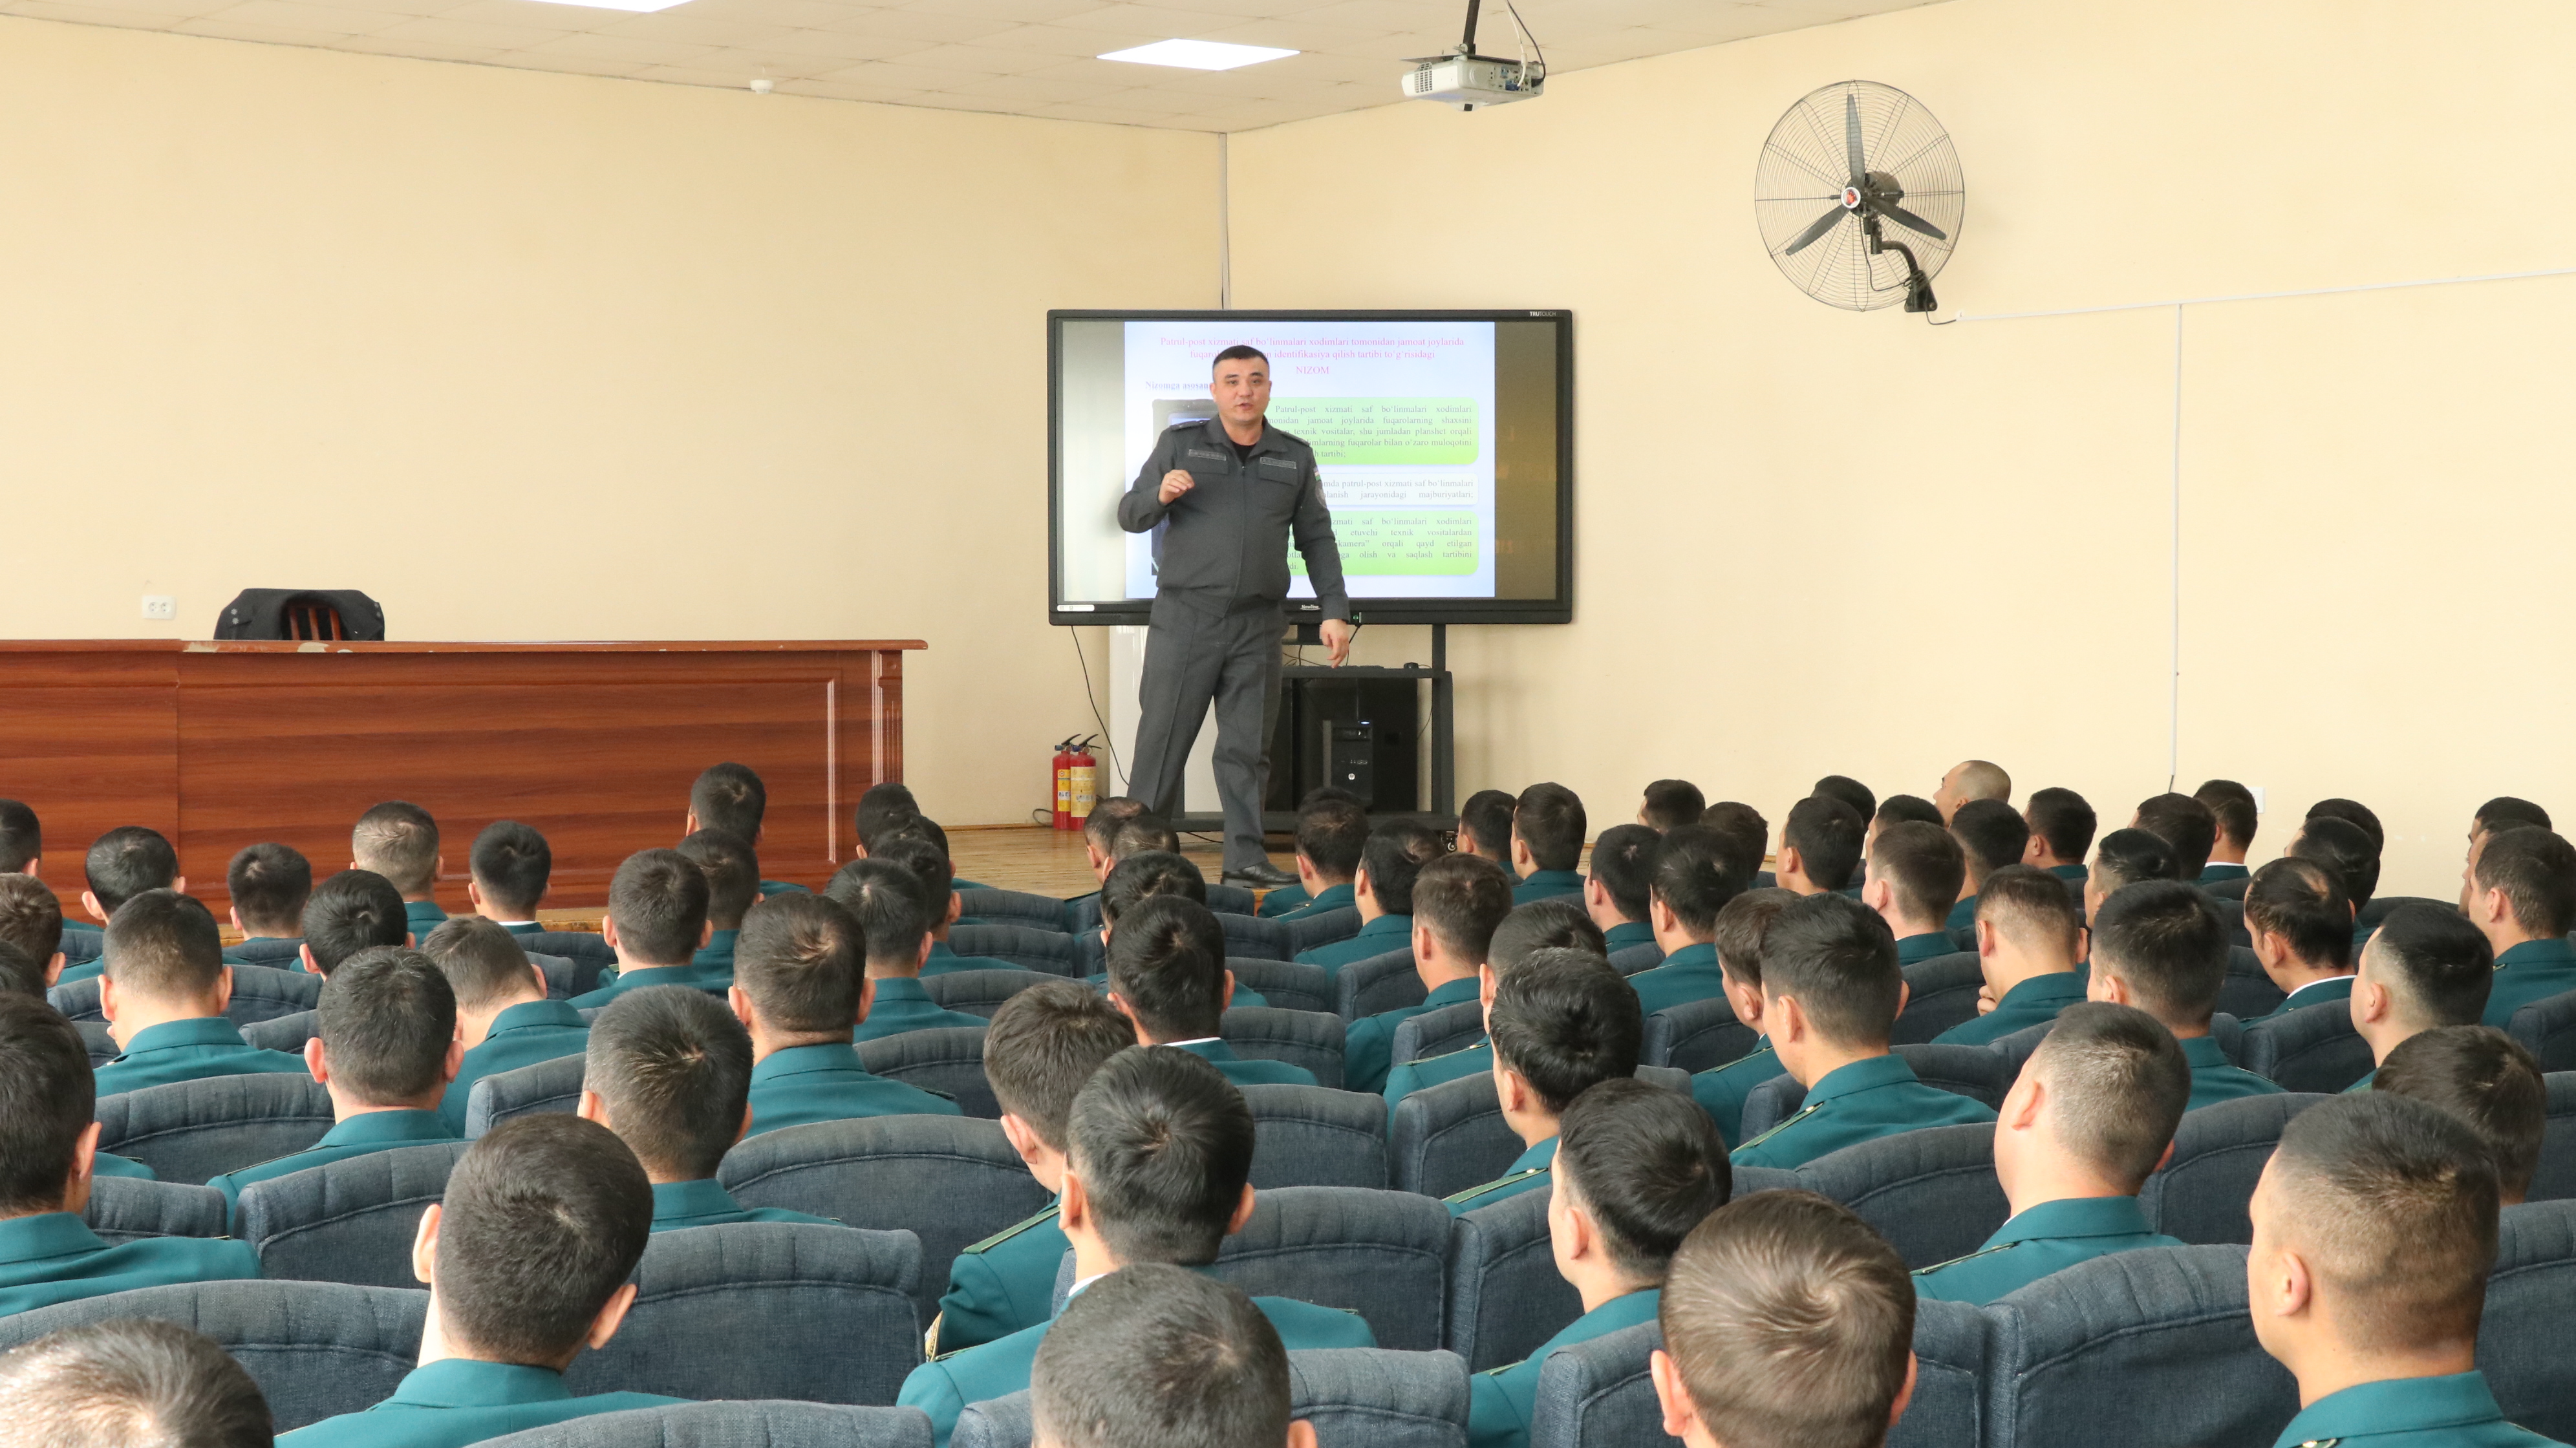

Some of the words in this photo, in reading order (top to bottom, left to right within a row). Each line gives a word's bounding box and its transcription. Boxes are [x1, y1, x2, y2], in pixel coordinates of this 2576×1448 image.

[1161, 337, 1206, 347] Patrul-post
[1397, 337, 1425, 347] jamoat
[1427, 337, 1465, 348] joylarida
[1190, 350, 1220, 361] fuqarol
[1274, 350, 1330, 360] identifikasiya
[1333, 350, 1355, 360] qilish
[1358, 350, 1382, 358] tartibi
[1296, 366, 1329, 374] NIZOM
[1145, 381, 1180, 390] Nizomga
[1276, 405, 1315, 414] Patrul-post
[1307, 416, 1333, 425] jamoat
[1340, 416, 1374, 425] joylarida
[1383, 416, 1433, 425] fuqarolarning
[1322, 427, 1355, 436] vositalar,
[1376, 427, 1410, 436] jumladan
[1415, 427, 1446, 436] planshet
[1450, 427, 1472, 436] orqali
[1348, 438, 1382, 447] fuqarolar
[1432, 438, 1472, 447] muloqotini
[1342, 480, 1382, 489] patrul-post
[1360, 491, 1406, 500] jarayonidagi
[1419, 491, 1474, 500] majburiyatlari;
[1382, 540, 1403, 549] orqali
[1417, 540, 1434, 549] qayd
[1447, 540, 1472, 549] etilgan
[1406, 551, 1433, 560] saqlash
